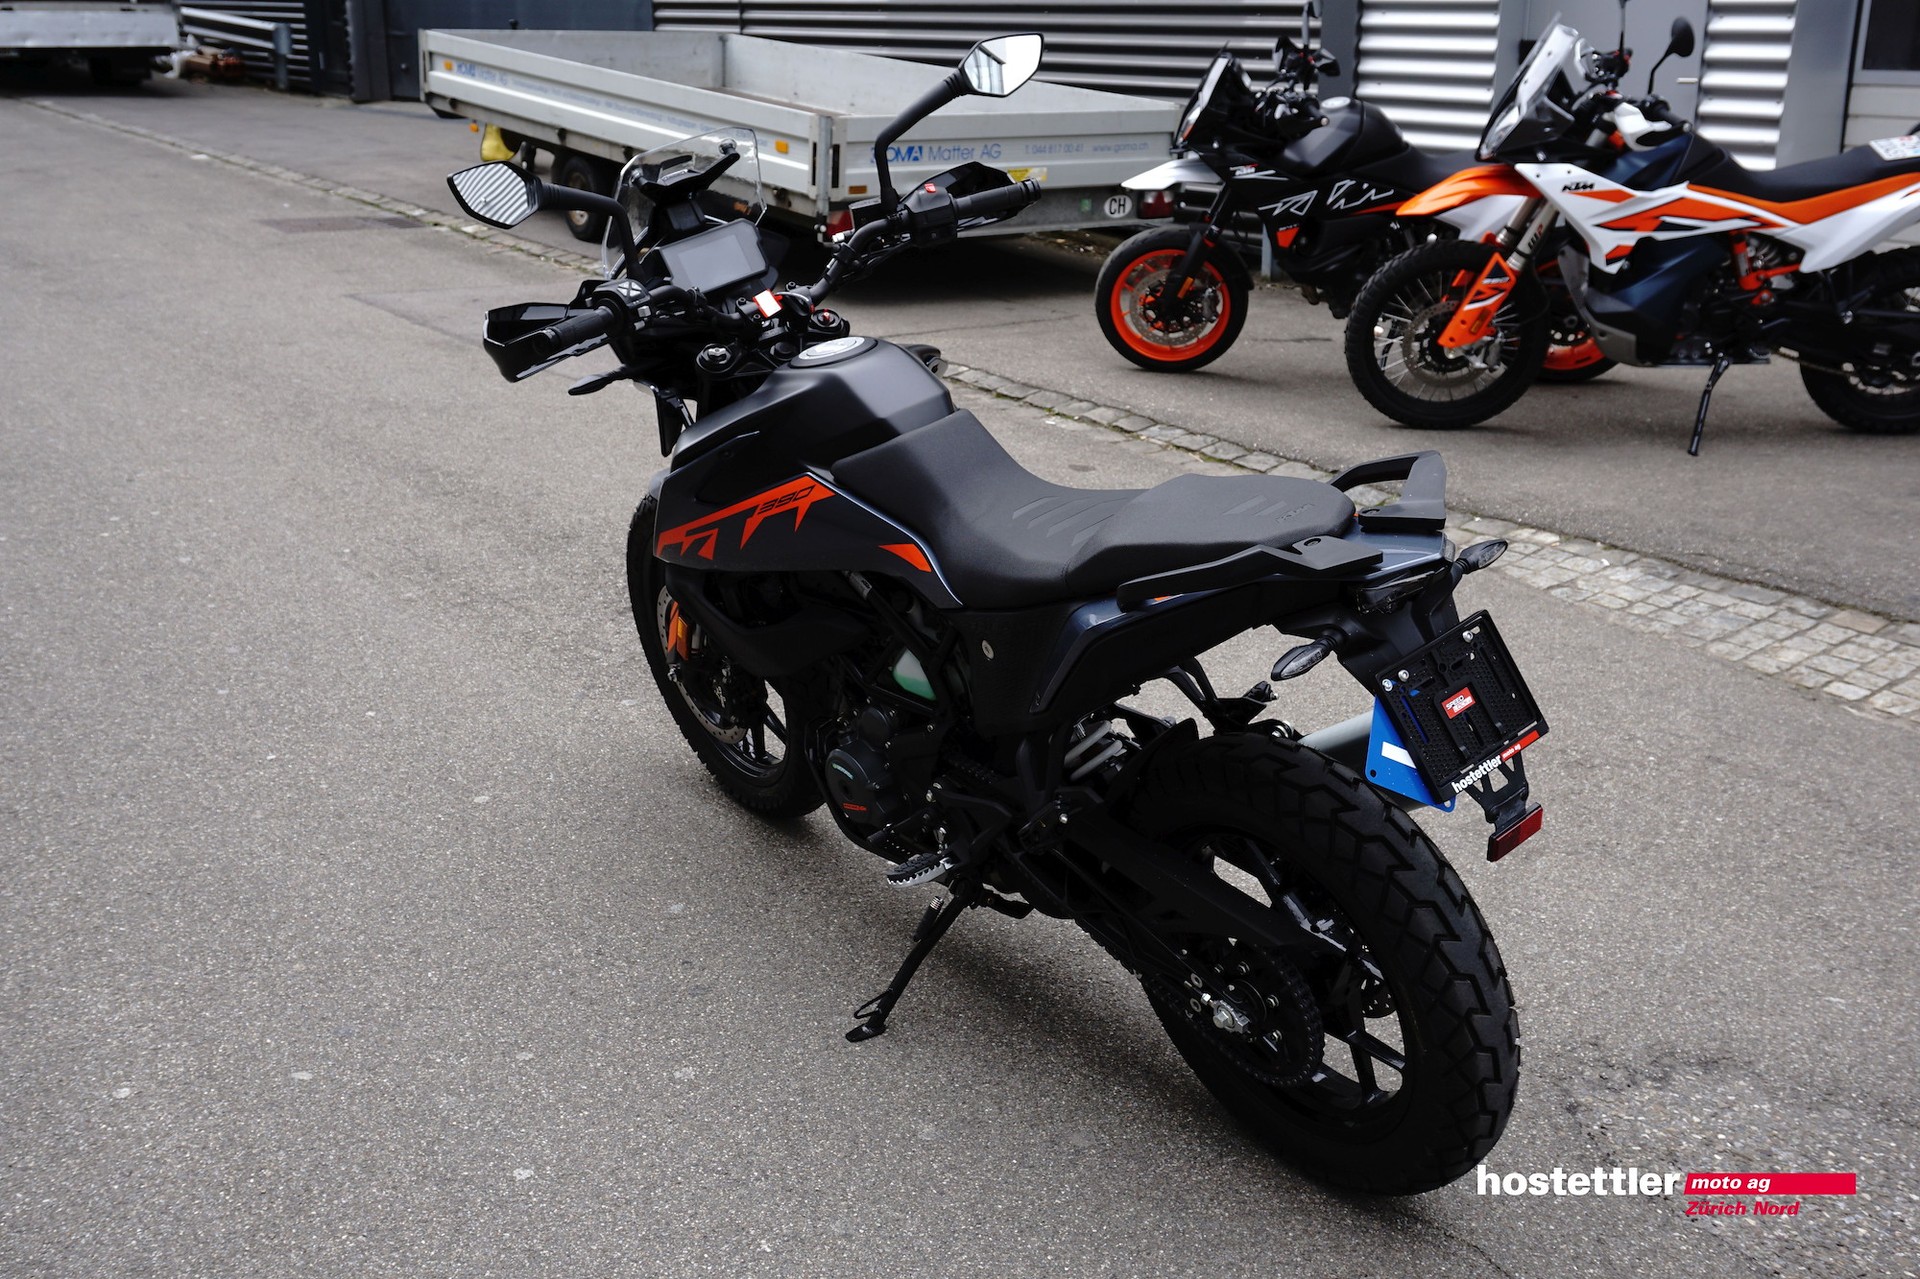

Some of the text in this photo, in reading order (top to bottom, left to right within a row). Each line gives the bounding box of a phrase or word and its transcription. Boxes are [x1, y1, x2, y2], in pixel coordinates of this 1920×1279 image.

[928, 146, 975, 161] Matter
[980, 143, 1002, 160] AG
[1562, 181, 1595, 192] KTM
[1109, 197, 1126, 215] CH
[1451, 754, 1502, 793] hostettler
